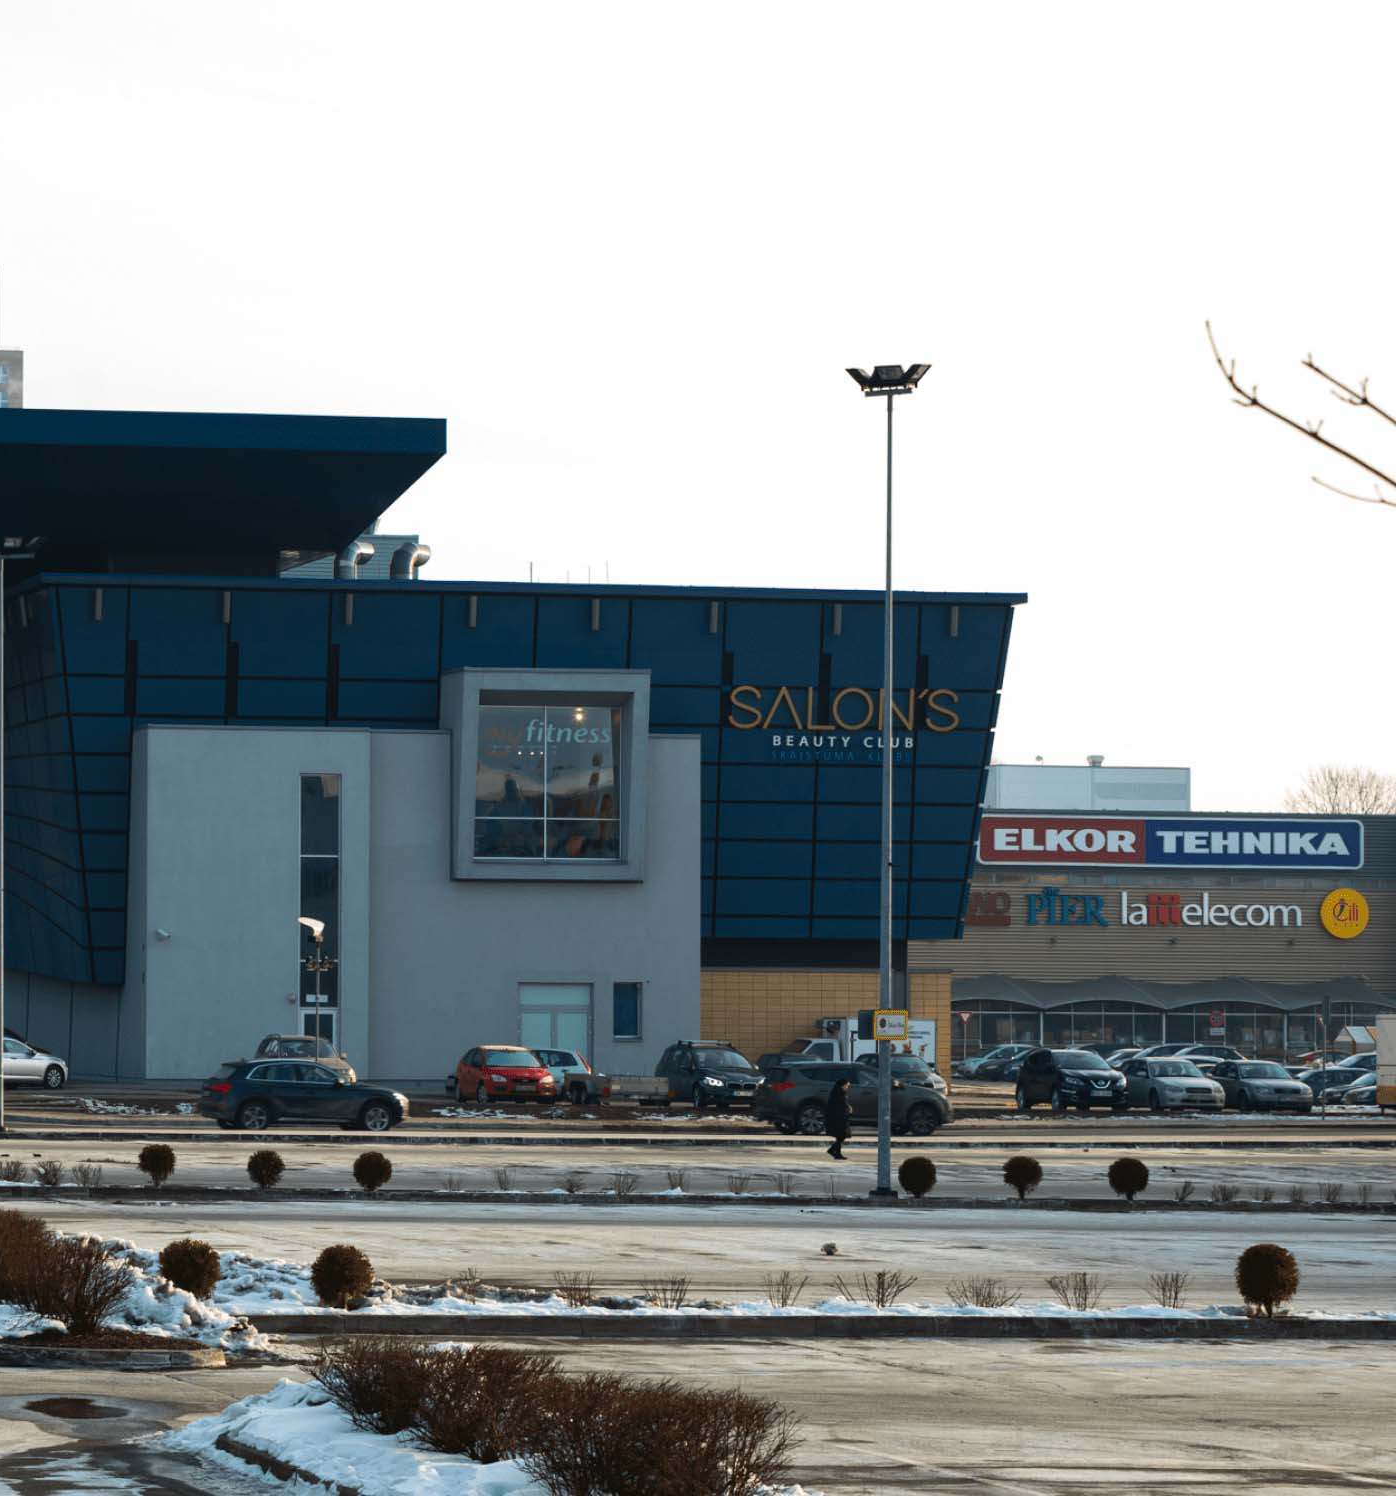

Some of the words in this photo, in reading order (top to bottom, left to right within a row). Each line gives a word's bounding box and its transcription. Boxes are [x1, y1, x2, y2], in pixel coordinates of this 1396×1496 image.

[728, 685, 960, 732] SALON'S
[526, 718, 611, 743] fitness
[772, 735, 851, 748] BEAUTY
[863, 736, 915, 749] CLUB
[993, 828, 1136, 853] ELKOR
[1156, 830, 1350, 856] TEHNIKA
[1027, 894, 1109, 927] PIER
